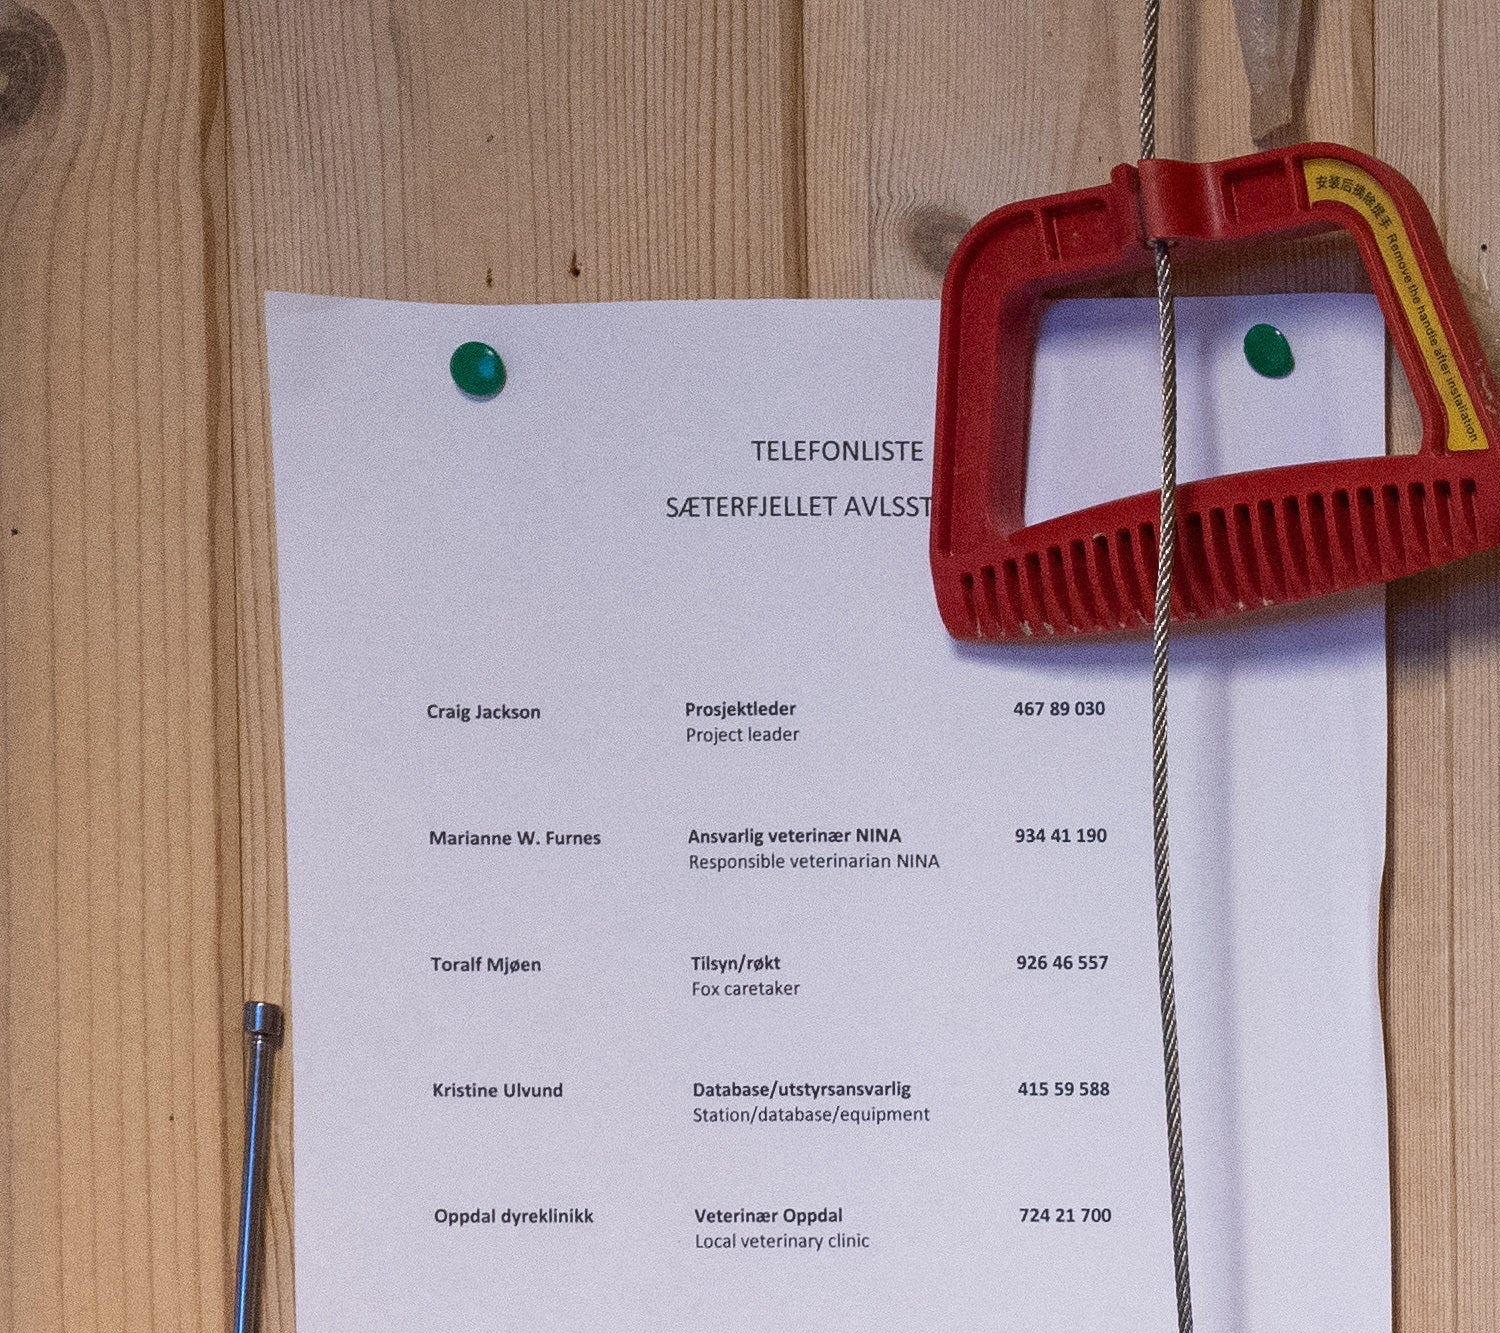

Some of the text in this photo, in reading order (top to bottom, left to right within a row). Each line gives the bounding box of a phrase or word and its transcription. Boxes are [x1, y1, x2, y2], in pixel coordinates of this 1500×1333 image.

[750, 440, 924, 462] TELEFONLISTE
[666, 494, 932, 519] SÆTERFJELLET AVLSST
[426, 703, 541, 723] Craig Jackson
[685, 700, 797, 720] Prosjektleder
[1013, 700, 1106, 717] 467 89 030
[686, 726, 800, 746] Project leader
[429, 830, 602, 846] Marianne W. Furnes
[687, 827, 902, 847] Ansvarlig veterinær NINA
[430, 956, 542, 976] Toralf Mjøen
[690, 953, 781, 974] Tilsyn/røkt
[692, 980, 801, 997] Fox caretaker
[432, 1082, 564, 1099] Kristine Ulvund
[693, 1080, 912, 1100] Database/utstyrsansvarlig
[693, 1105, 930, 1125] Station/database/equipment
[433, 1208, 594, 1227] Oppdal dyreklinikk
[694, 1207, 843, 1227] Veterinær Oppdal
[1019, 1207, 1112, 1223] 724 21 700
